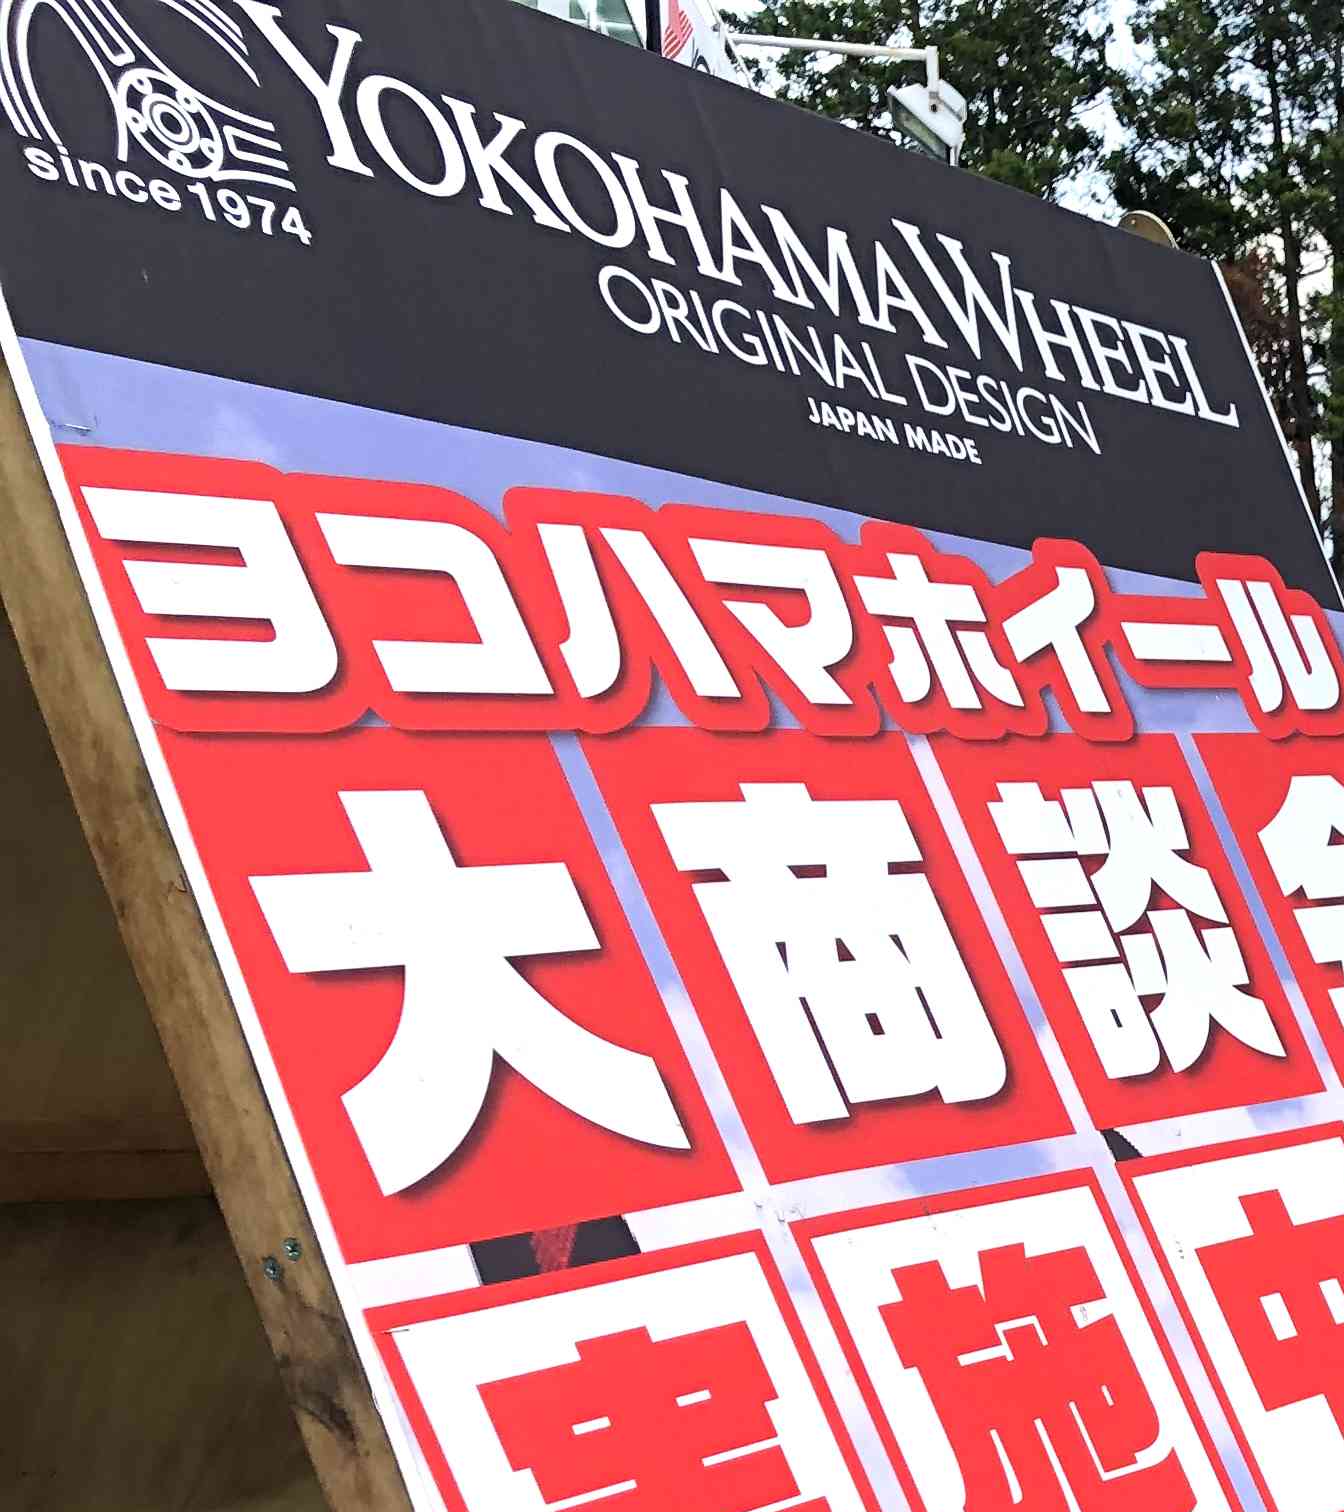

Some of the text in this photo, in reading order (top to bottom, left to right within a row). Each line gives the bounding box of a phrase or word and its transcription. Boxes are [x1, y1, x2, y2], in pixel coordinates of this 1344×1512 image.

[25, 143, 313, 246] since 1974
[245, 0, 1240, 428] YOKOHAMA WHEEL
[598, 265, 1103, 456] ORIGINAL DESIGN
[807, 398, 983, 466] JAPAN MADE
[80, 486, 1341, 713] ヨコハマホイール
